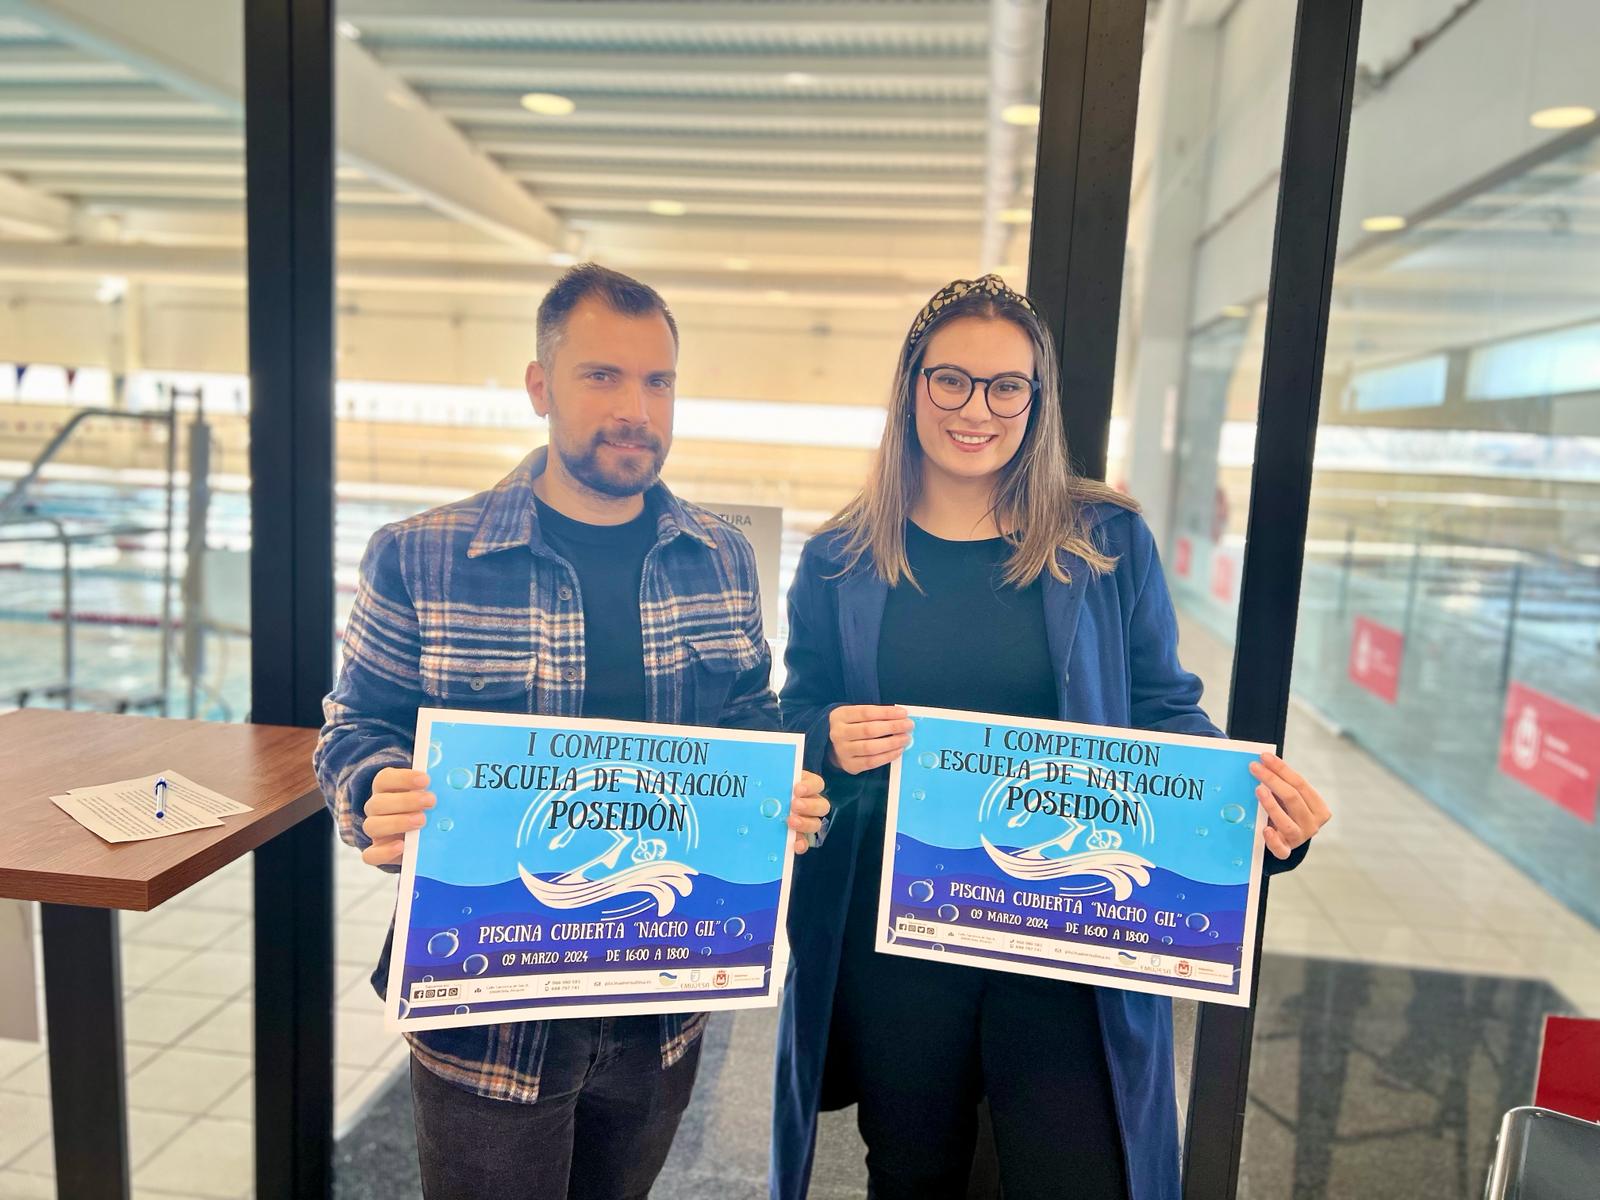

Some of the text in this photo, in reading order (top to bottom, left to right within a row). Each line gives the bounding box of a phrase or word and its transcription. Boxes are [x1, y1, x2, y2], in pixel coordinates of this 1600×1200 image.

[527, 732, 710, 765] I COMPETICIÓN
[983, 727, 1161, 768] I COMPETICIÓN
[473, 763, 748, 798] ESCUELA DE NATACIÓN
[938, 749, 1206, 802] ESCUELA DE NATACIÓN
[547, 799, 688, 832] POSEIDÓN
[1006, 785, 1141, 827] POSEIDÓN
[949, 881, 1006, 905] PISCINA
[1013, 890, 1084, 915] CUBIERTA
[478, 924, 542, 945] PISCINA
[551, 922, 625, 942] CUBIERTA
[970, 908, 1149, 944] 09 MARZO 2024 DE 16:00 A 18:00
[502, 954, 516, 966] 09
[521, 952, 560, 965] MARZO
[564, 950, 589, 964] 2024
[605, 949, 621, 962] DE
[654, 948, 662, 960] A
